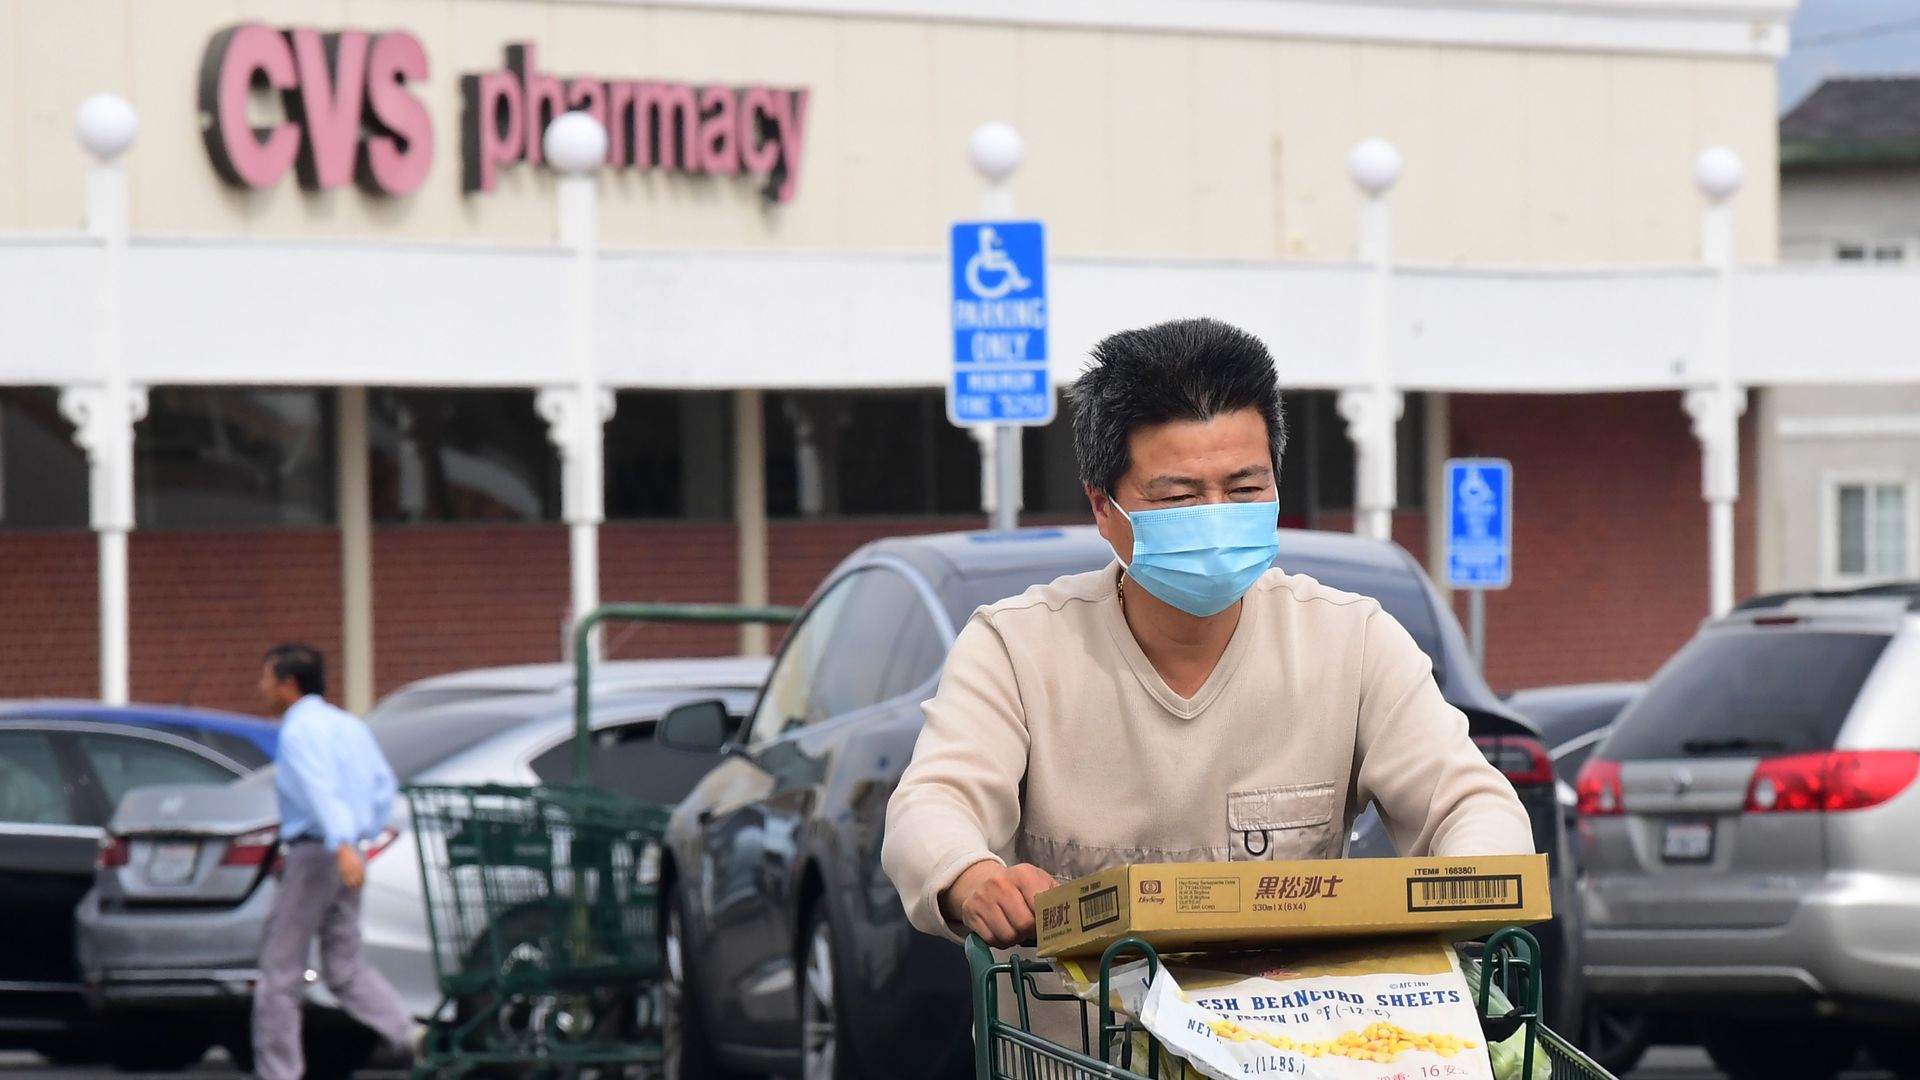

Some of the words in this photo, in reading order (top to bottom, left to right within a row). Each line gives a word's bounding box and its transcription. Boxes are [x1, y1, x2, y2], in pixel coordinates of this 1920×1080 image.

[203, 23, 434, 196] CVS
[1414, 868, 1440, 876] ITEM#
[1255, 875, 1344, 900] 黑松沙士
[1251, 990, 1364, 1011] BEANCURD
[1376, 990, 1460, 1007] SHEETS
[1294, 1012, 1309, 1023] 10
[1420, 1064, 1440, 1078] 16
